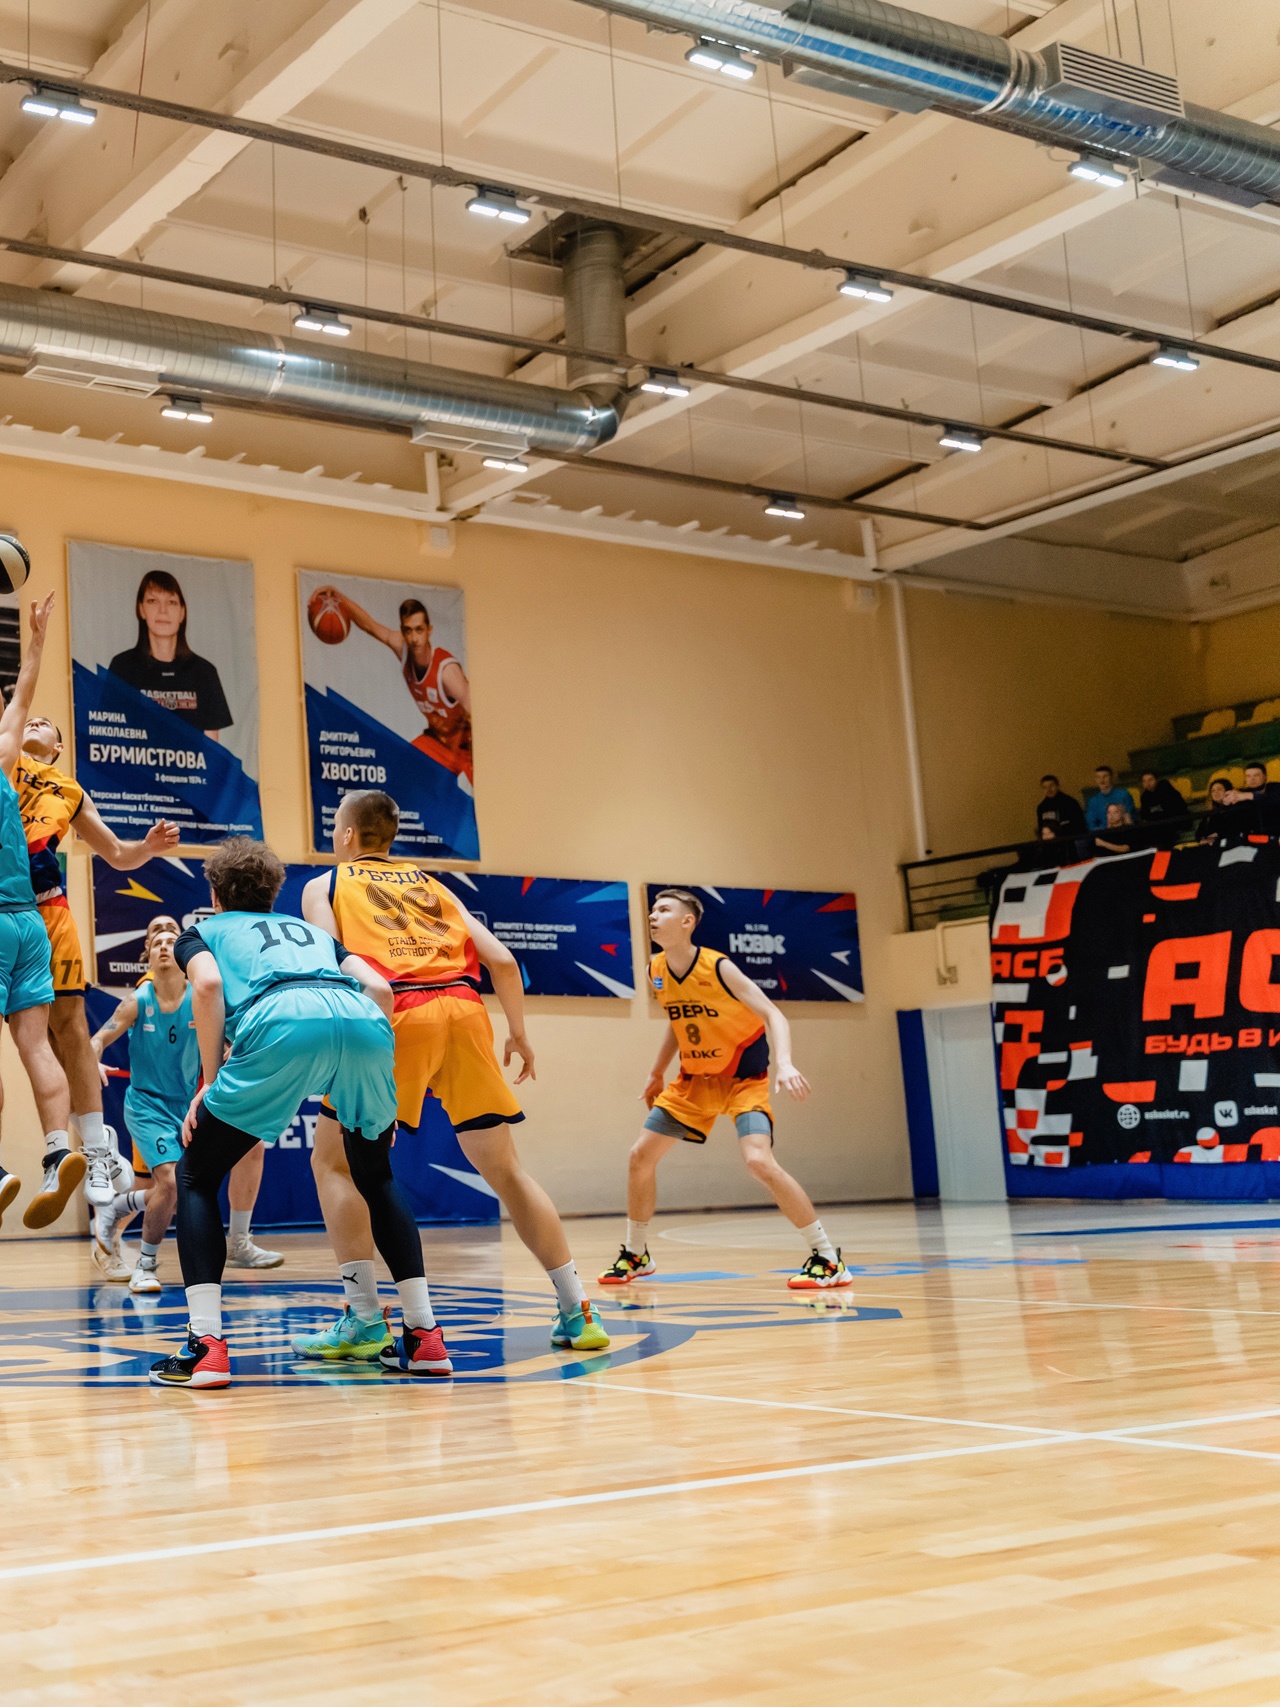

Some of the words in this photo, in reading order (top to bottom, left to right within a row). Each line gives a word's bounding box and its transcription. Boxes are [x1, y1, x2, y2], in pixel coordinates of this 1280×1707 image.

[88, 711, 126, 724] МАРИНА
[89, 725, 148, 740] НИКОЛАЕВНА
[319, 730, 359, 743] ДМИТРИЙ
[89, 743, 207, 769] БУРМИСТРОВА
[320, 744, 376, 758] ГРИГОРЬЕВИЧ
[321, 761, 387, 783] ХВОСТОВ
[94, 802, 137, 812] оспитанница
[251, 919, 316, 953] 10
[389, 947, 434, 957] КОСТНОГО
[61, 959, 82, 985] 77
[664, 1004, 719, 1021] ВЕРЬ
[169, 1025, 177, 1044] 6
[685, 1023, 701, 1046] 8
[1144, 1032, 1234, 1056] БУДЬ
[1237, 1027, 1263, 1048] В
[691, 1048, 723, 1059] DKC
[156, 1136, 168, 1155] 6
